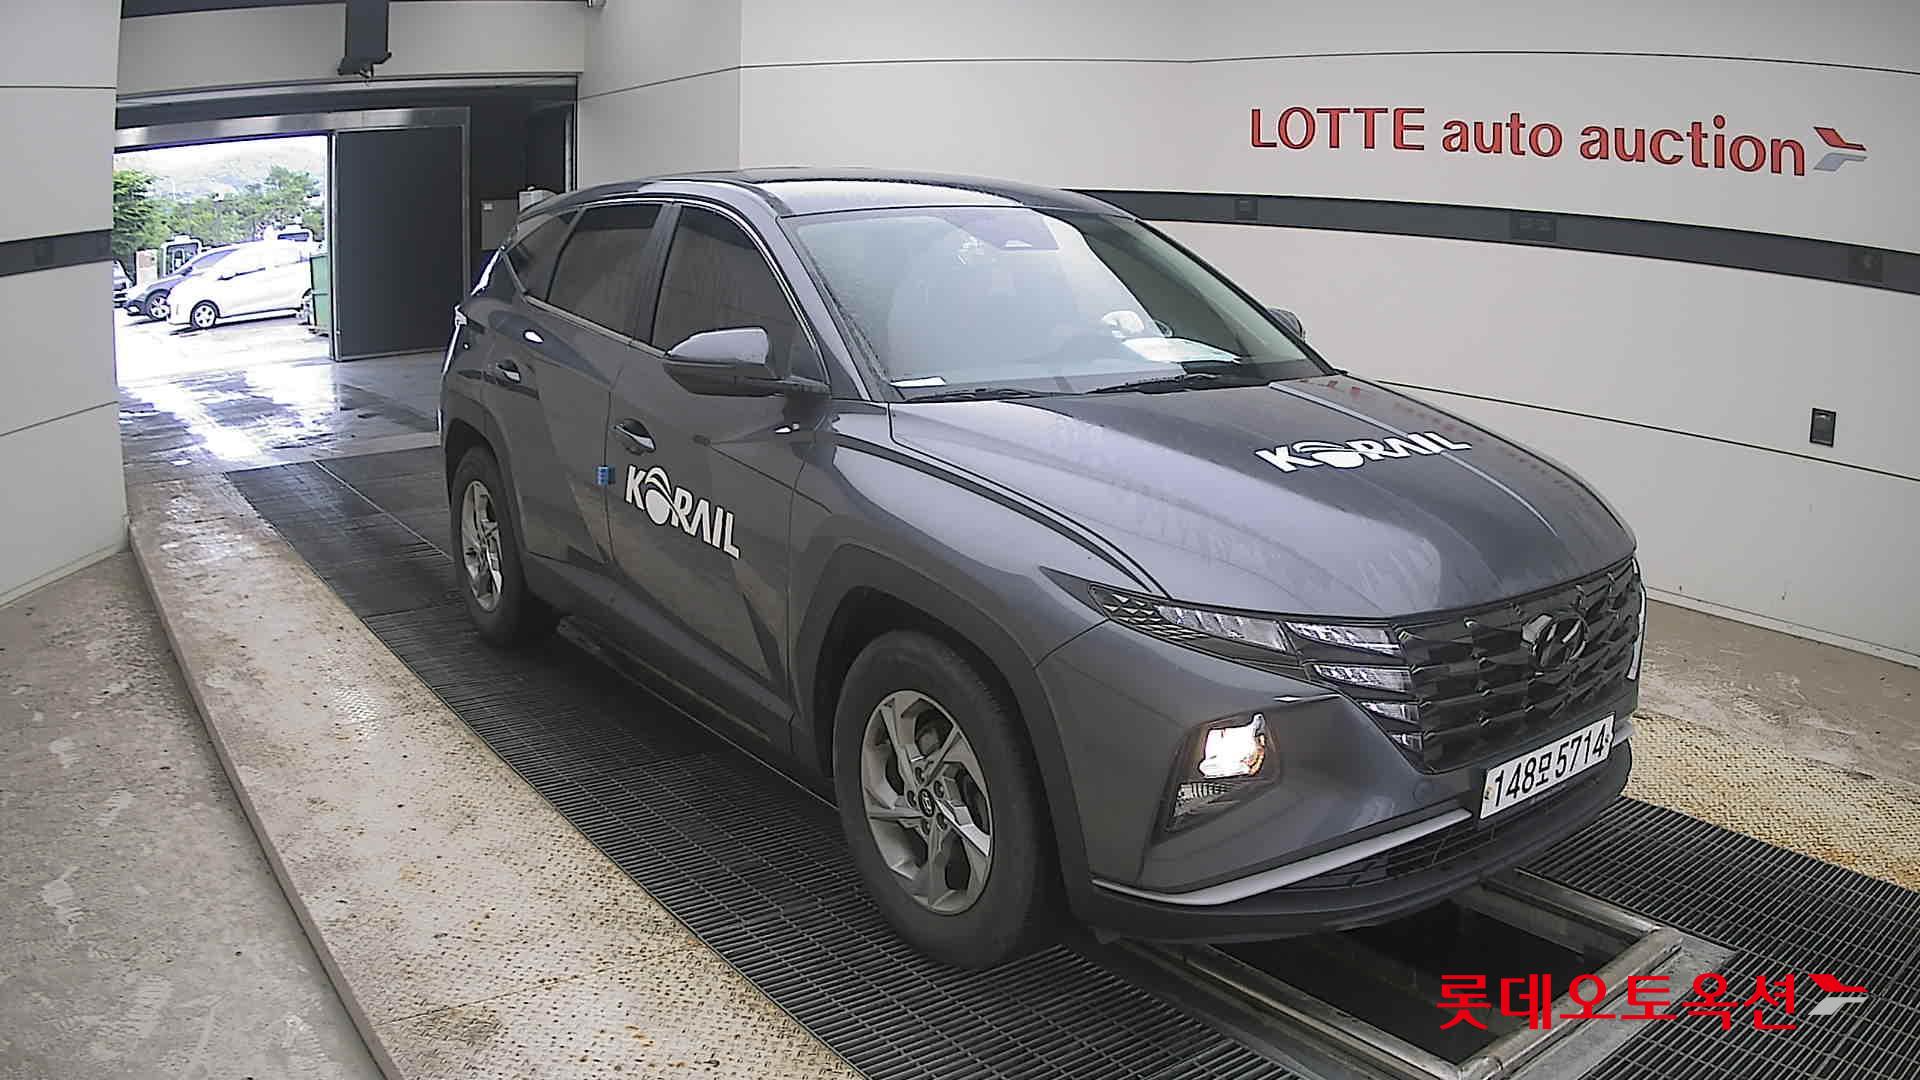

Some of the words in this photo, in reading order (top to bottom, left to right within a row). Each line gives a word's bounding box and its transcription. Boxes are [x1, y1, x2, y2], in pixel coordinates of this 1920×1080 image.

[1250, 107, 1425, 150] LOTTE
[1442, 113, 1563, 157] auto
[1580, 115, 1806, 176] auction
[1255, 431, 1473, 473] KORAIL
[625, 465, 740, 560] KORAIL
